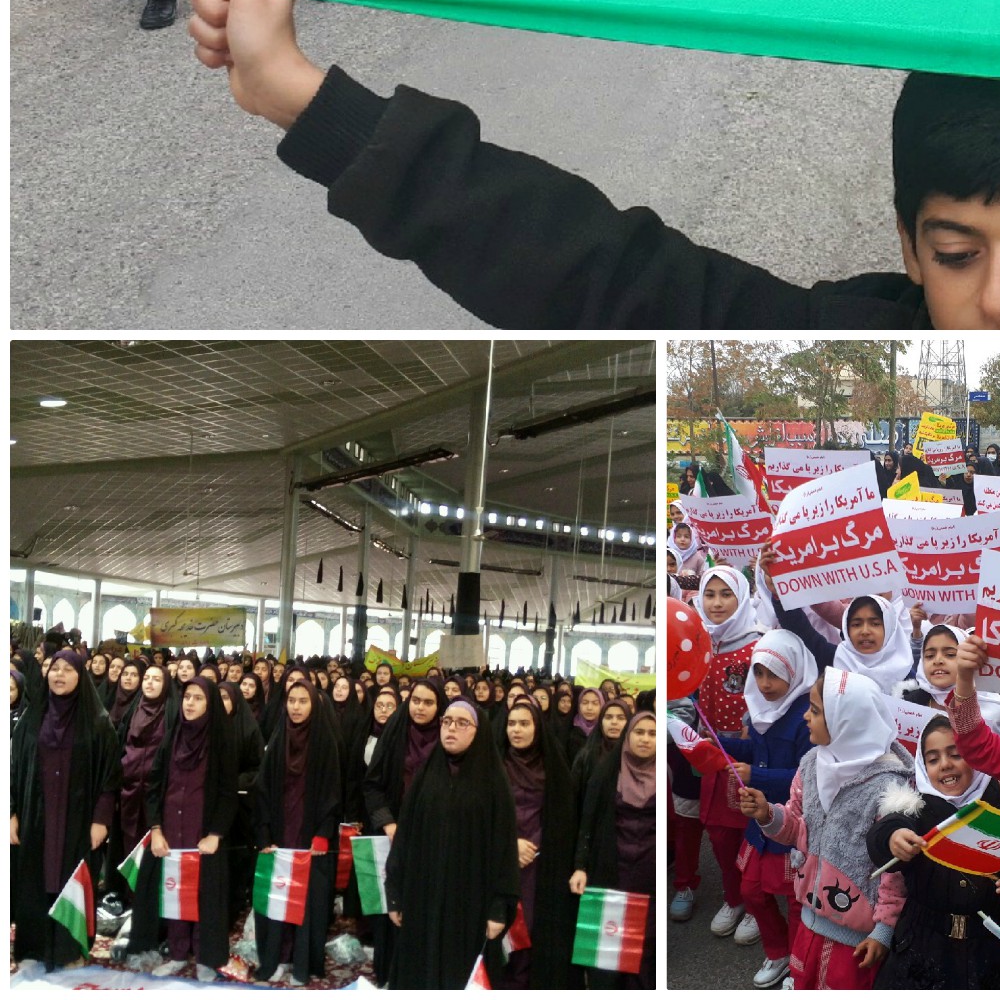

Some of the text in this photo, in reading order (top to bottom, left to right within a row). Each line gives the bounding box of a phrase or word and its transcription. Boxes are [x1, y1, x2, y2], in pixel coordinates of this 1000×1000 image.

[835, 487, 863, 510] آمریکا
[865, 488, 875, 500] ما
[811, 505, 824, 520] زیر
[825, 500, 835, 515] را
[720, 523, 769, 541] مرگ بر
[968, 528, 999, 545] آمریکا
[817, 521, 883, 559] مرگ بر
[917, 541, 929, 549] می
[941, 537, 955, 549] زیر
[957, 536, 966, 548] را
[721, 549, 745, 557] WITH
[777, 559, 898, 596] DOWN WITH U.S.A
[939, 562, 965, 581] بر
[902, 588, 975, 601] DOWN WITH
[218, 617, 244, 637] دبیرستان
